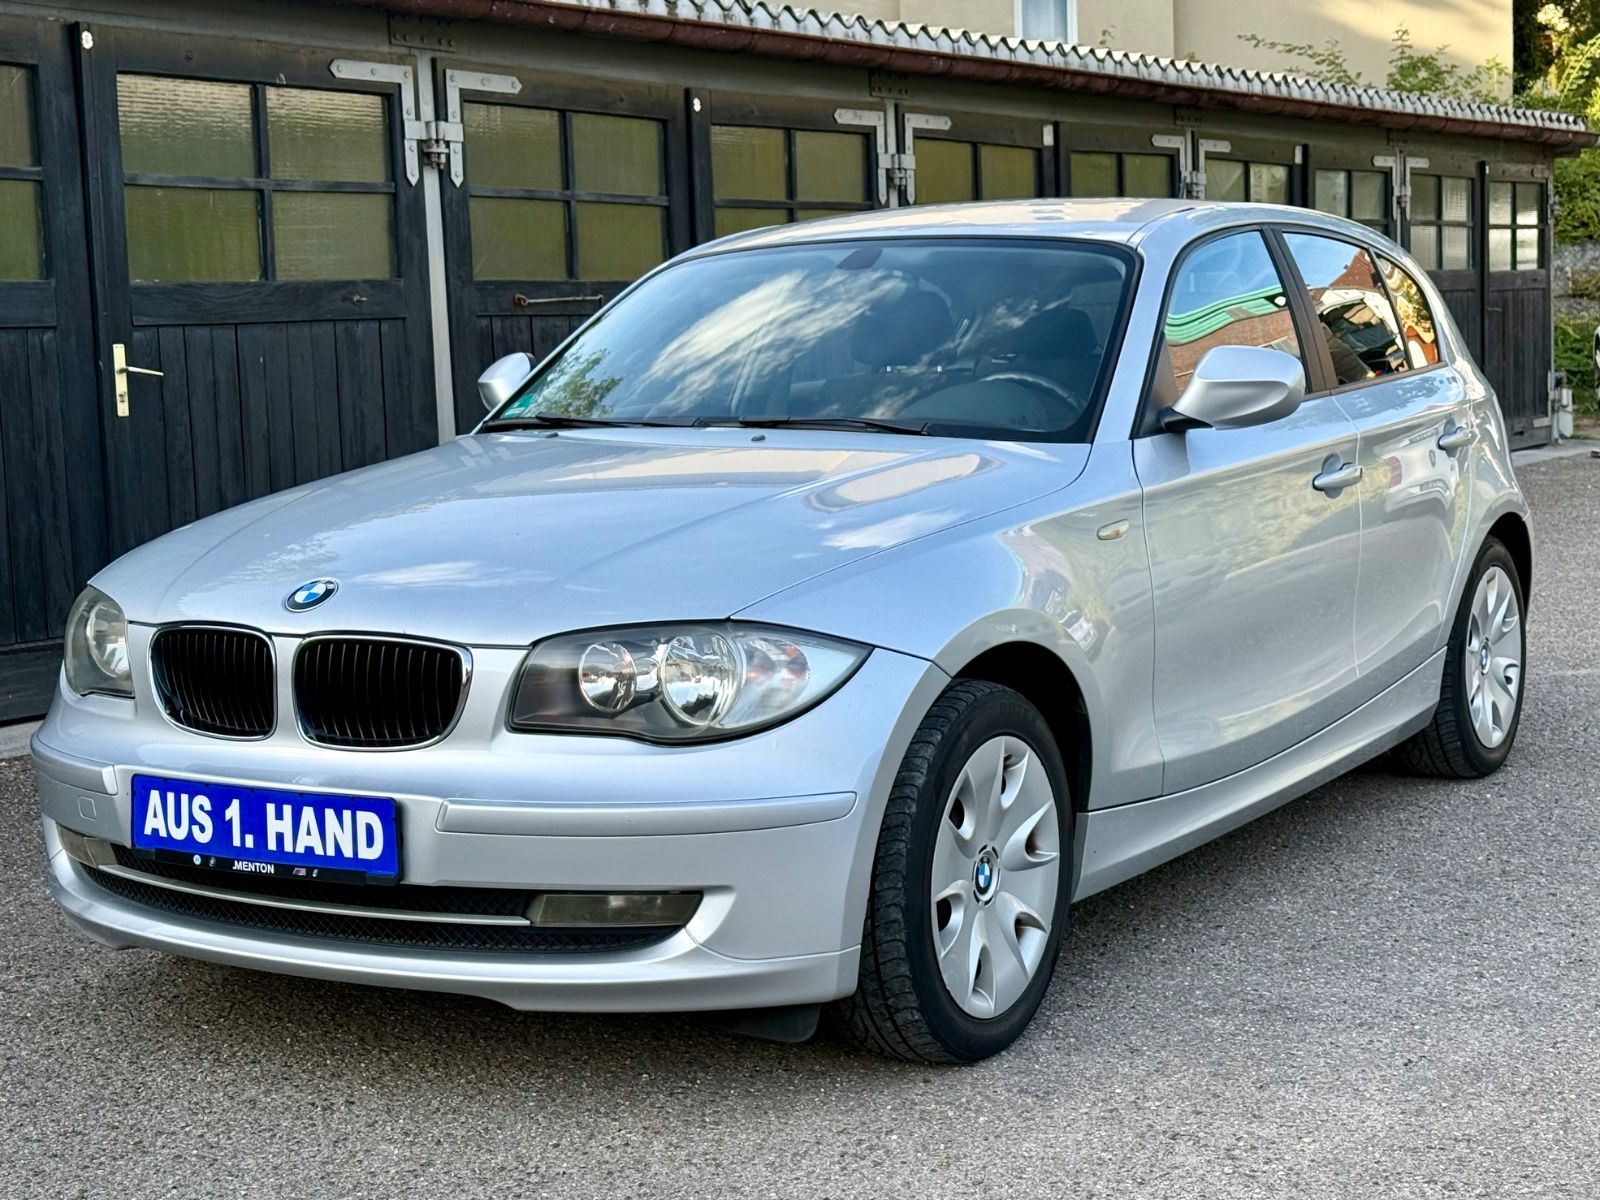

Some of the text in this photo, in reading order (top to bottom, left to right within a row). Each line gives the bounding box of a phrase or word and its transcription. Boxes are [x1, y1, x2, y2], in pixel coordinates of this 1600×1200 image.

[143, 789, 384, 860] AUS 1. HAND
